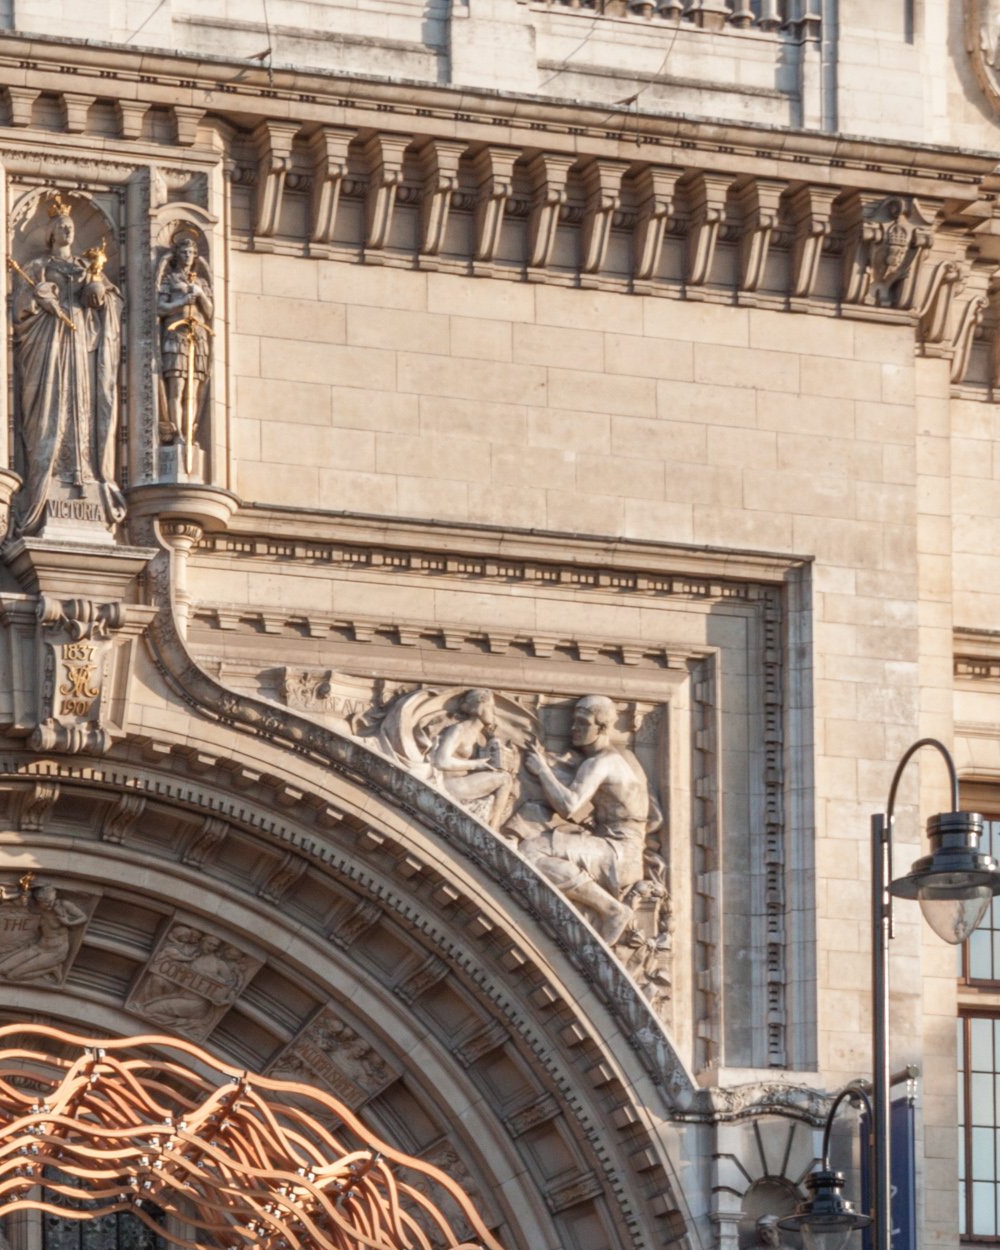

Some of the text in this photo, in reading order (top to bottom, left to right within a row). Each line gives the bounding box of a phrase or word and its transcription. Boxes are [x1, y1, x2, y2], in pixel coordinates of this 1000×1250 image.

[47, 499, 106, 522] VICTORIA
[61, 643, 96, 662] 1837
[59, 700, 89, 717] 1901
[4, 917, 32, 932] THE
